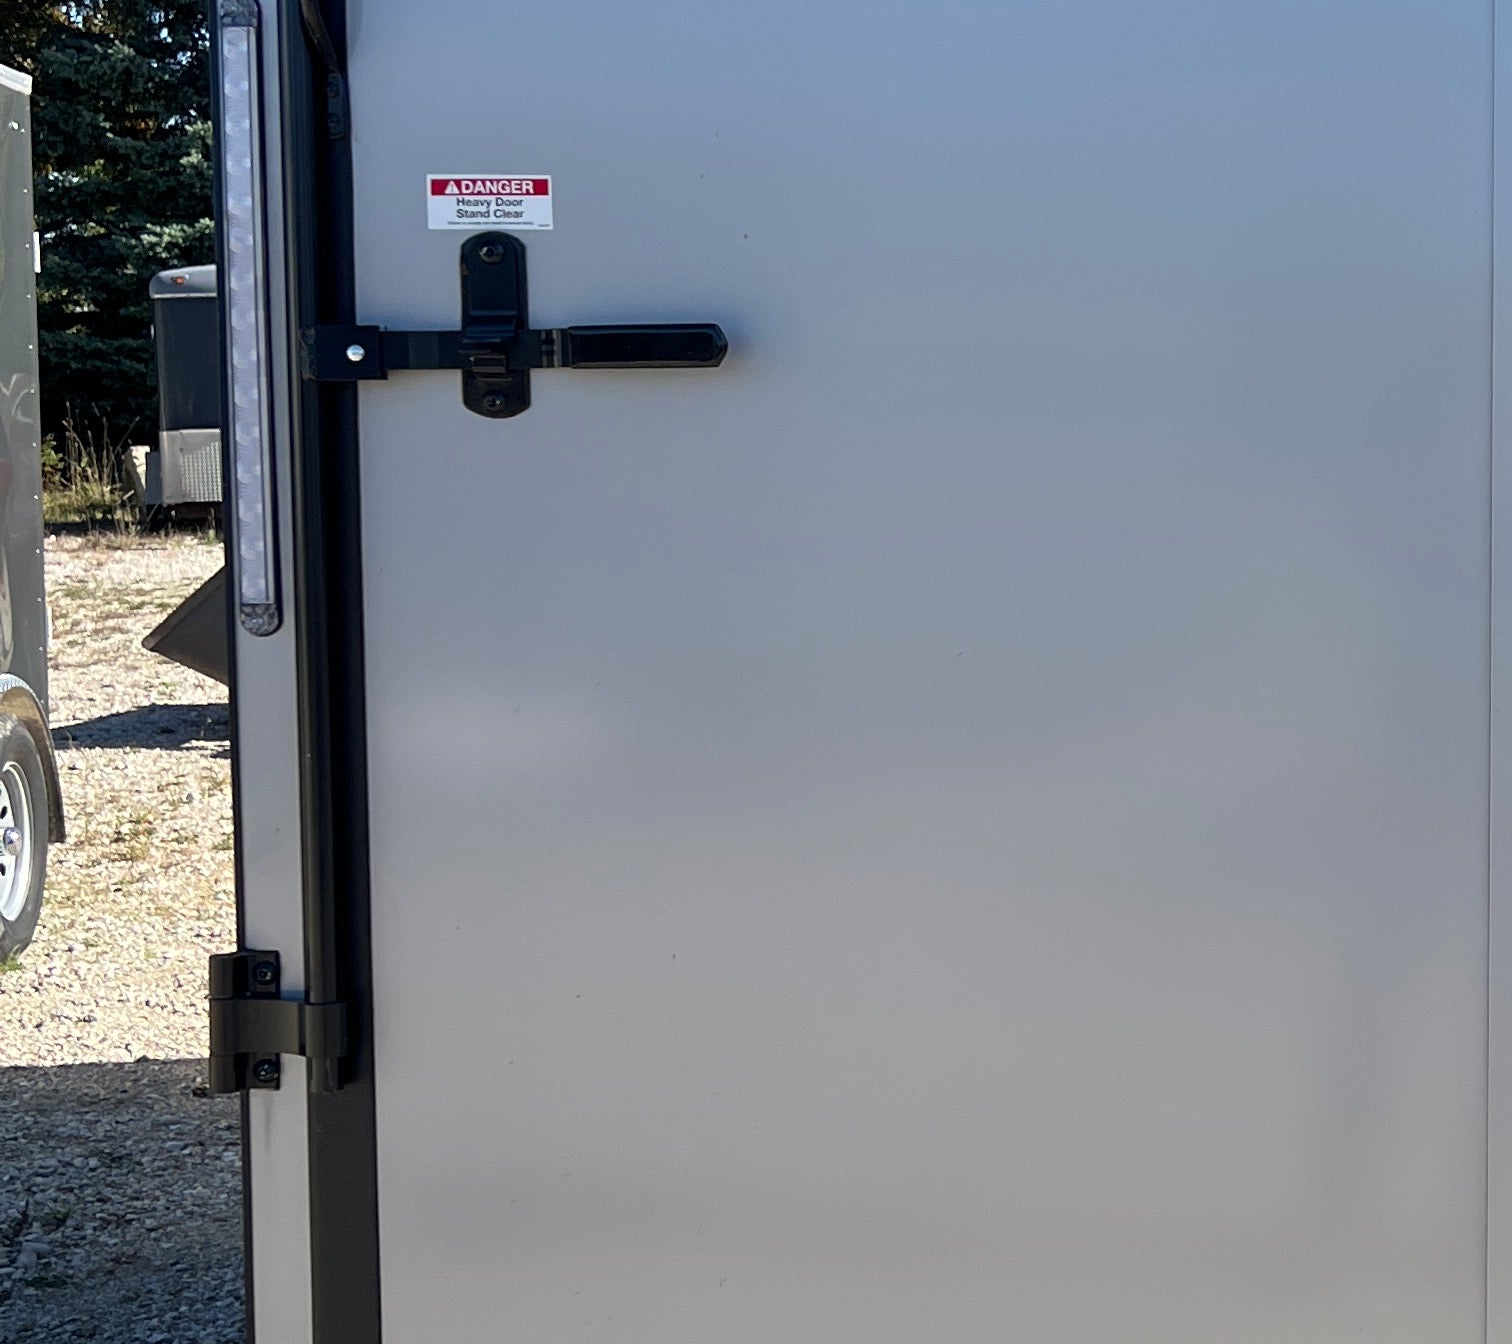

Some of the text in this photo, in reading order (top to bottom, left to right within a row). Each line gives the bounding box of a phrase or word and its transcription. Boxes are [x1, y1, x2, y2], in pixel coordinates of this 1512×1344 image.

[461, 180, 534, 194] DANGER
[456, 197, 524, 209] Heavy Door
[456, 208, 525, 219] Stand Clear
